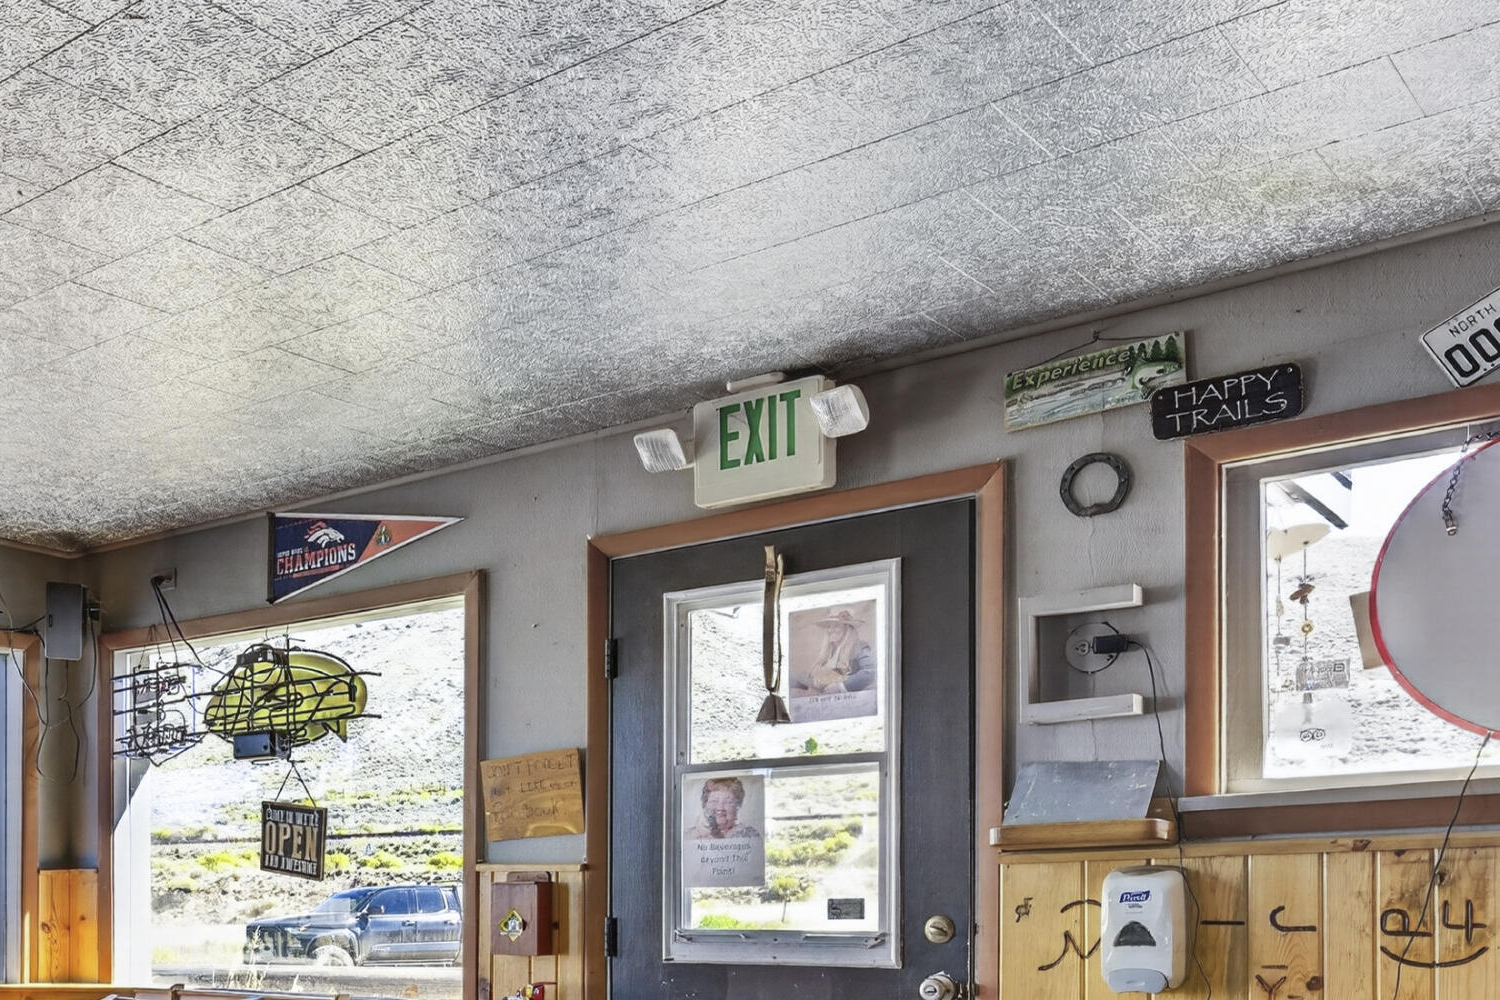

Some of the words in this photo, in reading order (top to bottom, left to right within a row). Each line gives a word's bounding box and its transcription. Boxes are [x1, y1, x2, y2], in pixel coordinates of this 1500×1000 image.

[1448, 304, 1497, 338] NORTH
[1012, 349, 1131, 390] Experience
[1174, 369, 1278, 409] HAPPY
[719, 389, 802, 471] EXIT
[1166, 391, 1288, 432] TRAILS
[276, 542, 356, 576] CHAMPIONS
[265, 821, 319, 861] OPEN
